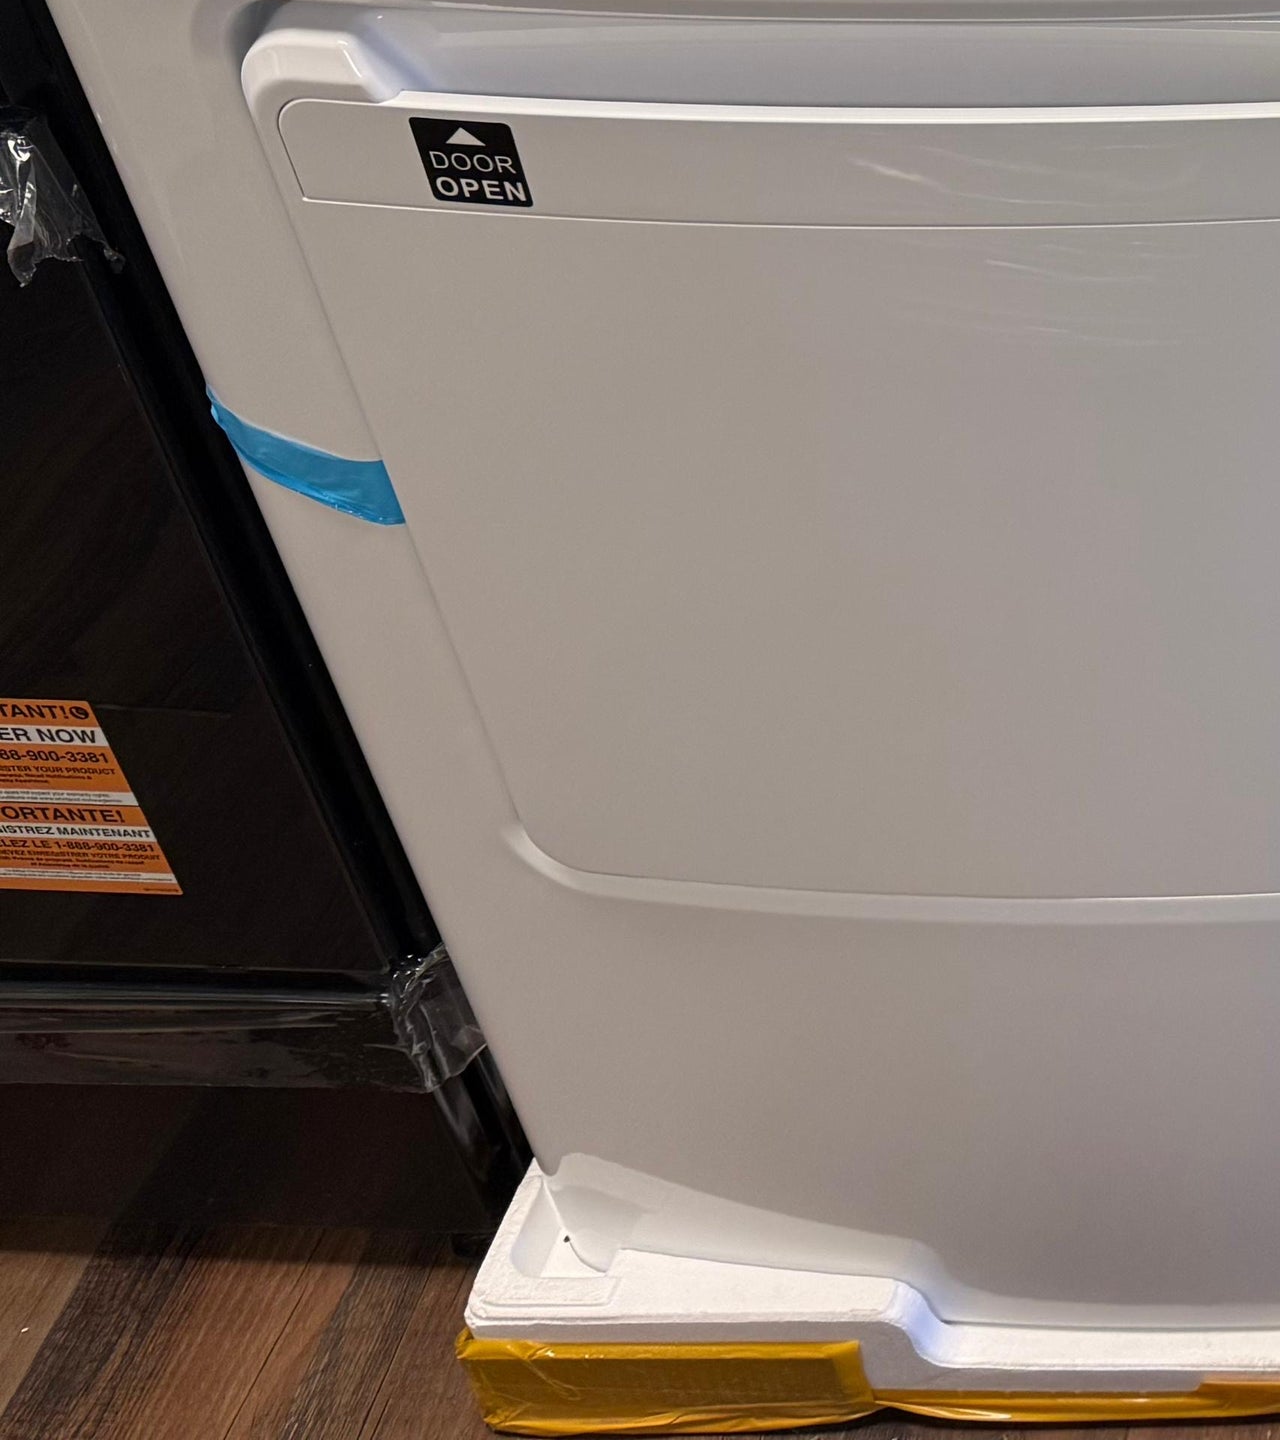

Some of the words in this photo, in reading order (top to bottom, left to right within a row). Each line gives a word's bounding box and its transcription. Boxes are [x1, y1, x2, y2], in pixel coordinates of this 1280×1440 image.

[429, 151, 517, 174] DOOR
[436, 176, 527, 202] OPEN
[0, 703, 69, 720] TANT!
[36, 728, 97, 744] NOW
[33, 765, 65, 774] YOUR
[65, 767, 117, 776] PRODUCT
[1, 805, 126, 824] ORTANTE!
[0, 824, 56, 836] ISTREZ
[56, 826, 151, 839] MAINTENANT
[0, 838, 29, 848] LEZ
[30, 839, 53, 849] LE
[56, 840, 155, 853] 1-888-900-3381
